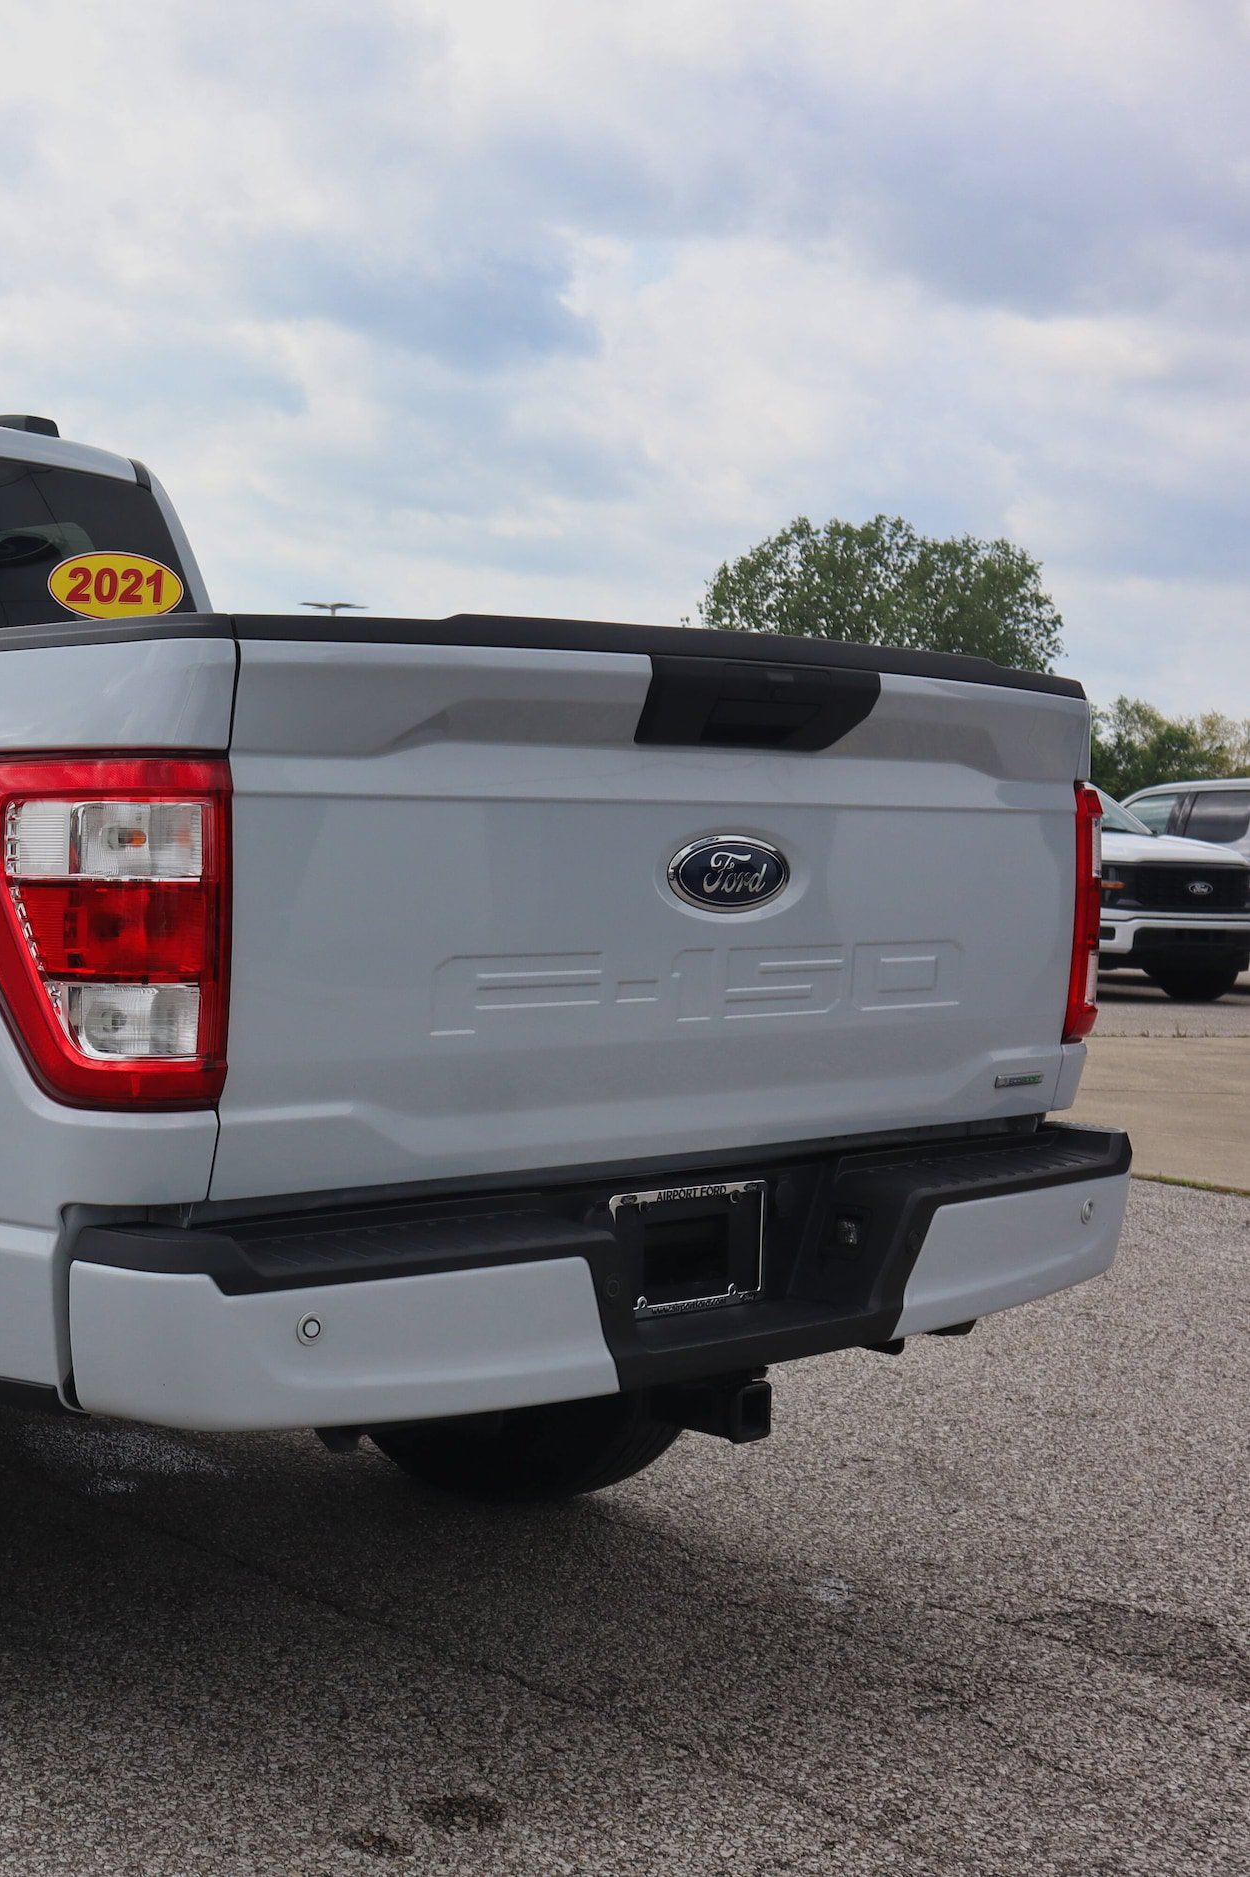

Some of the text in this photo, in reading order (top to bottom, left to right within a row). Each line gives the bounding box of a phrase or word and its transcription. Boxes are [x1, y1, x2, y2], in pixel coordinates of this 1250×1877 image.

[65, 567, 164, 605] 2021
[703, 851, 768, 894] Ford
[430, 939, 964, 1036] F-150
[656, 1185, 727, 1201] AIRPORT FORD
